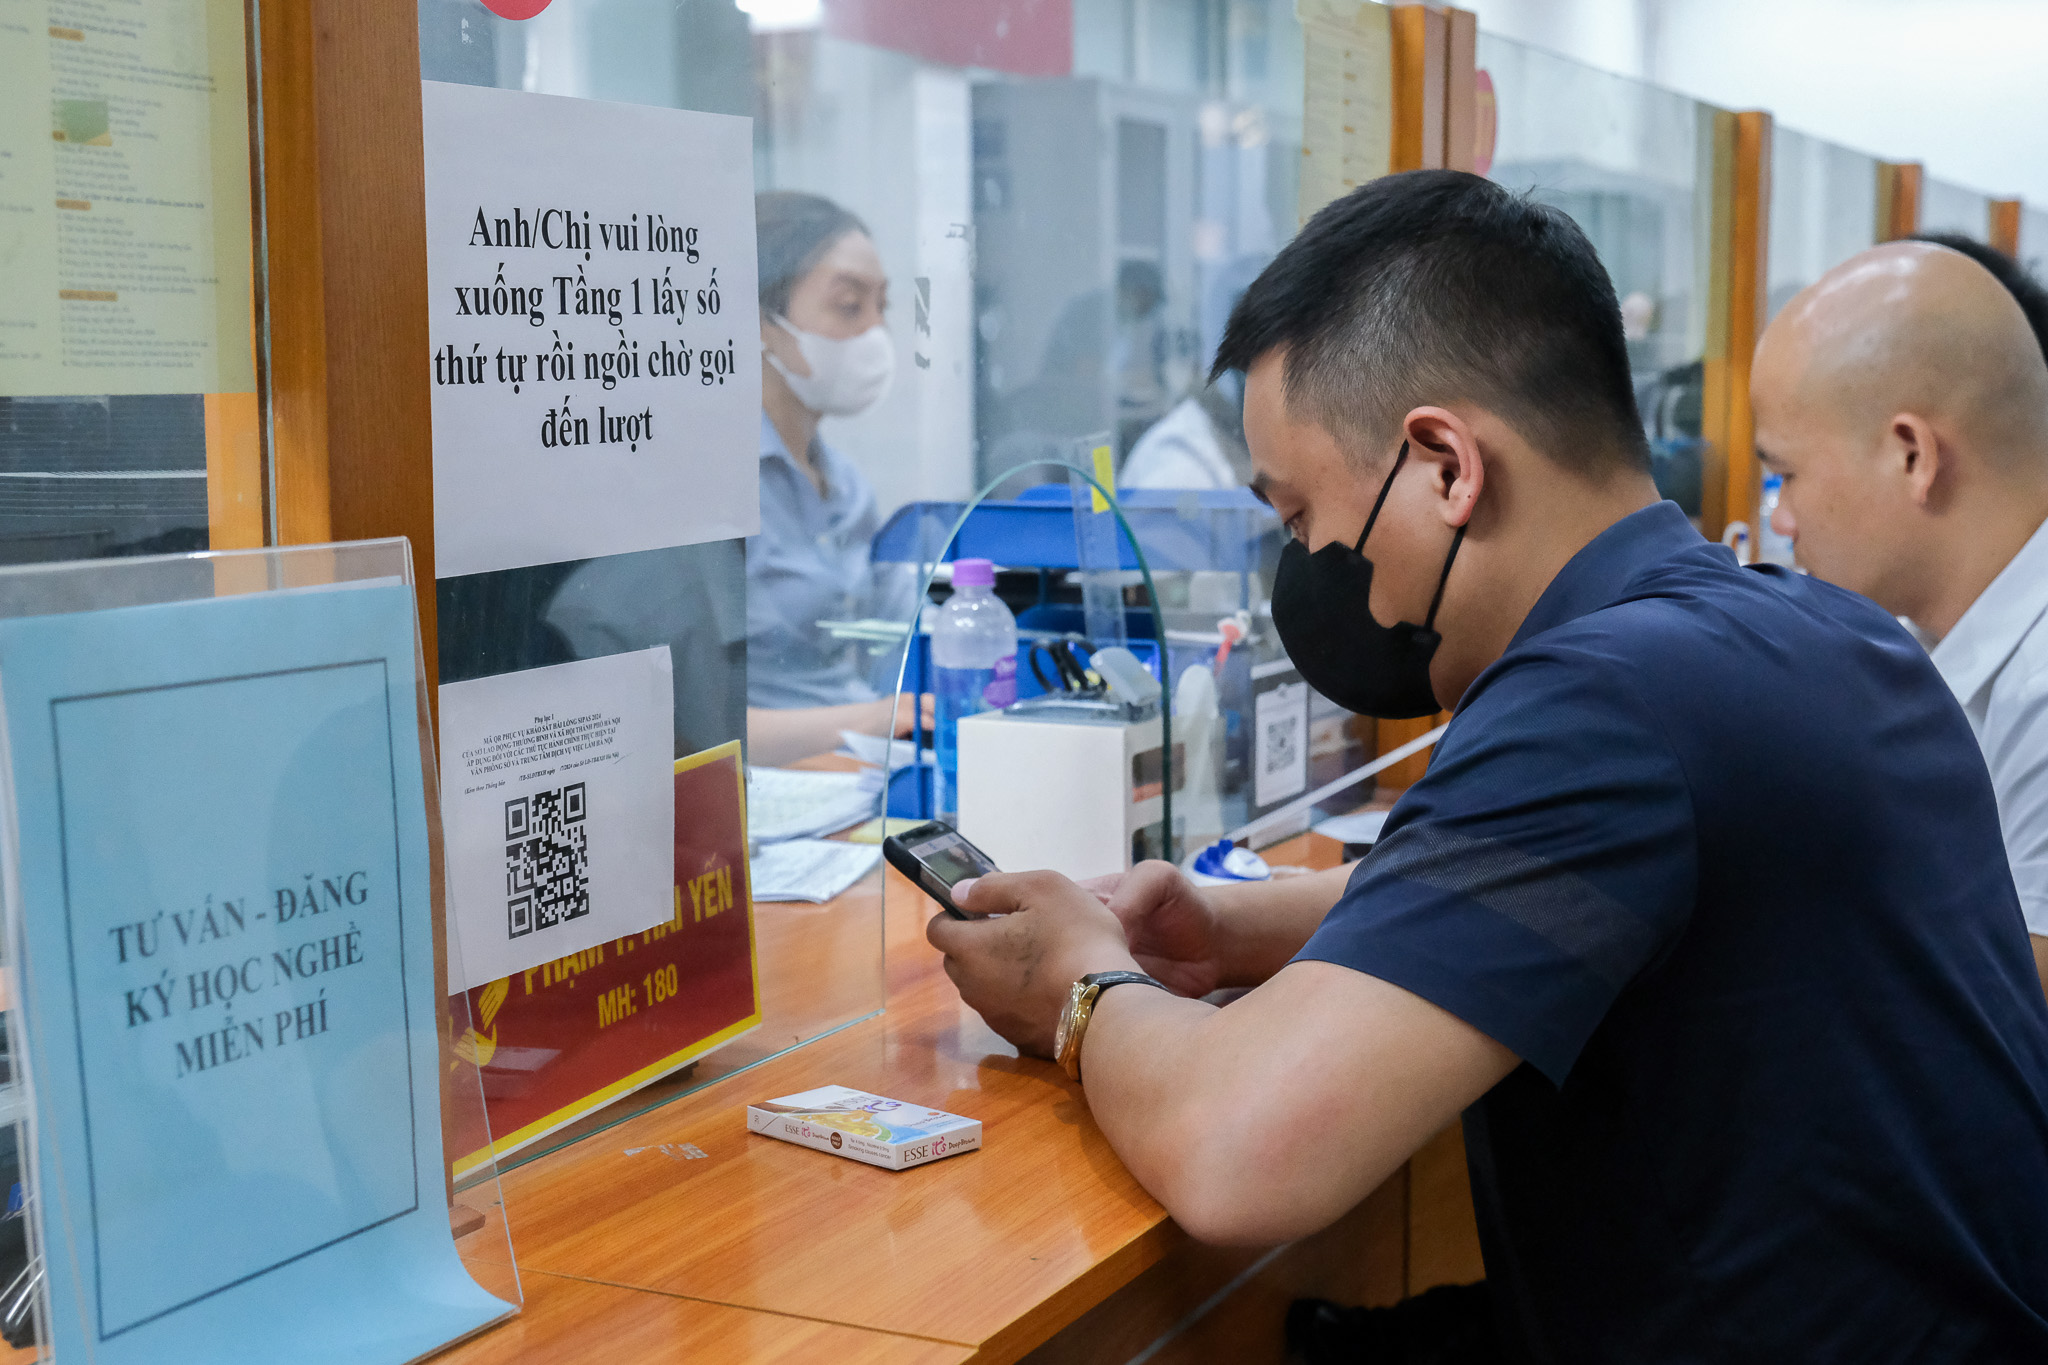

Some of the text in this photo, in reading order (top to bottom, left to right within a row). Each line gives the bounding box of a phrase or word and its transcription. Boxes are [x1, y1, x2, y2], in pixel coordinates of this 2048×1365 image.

[469, 205, 700, 264] Anh/Chị vui lòng
[455, 262, 721, 327] xuống Tầng 1 lấy số
[434, 329, 736, 395] thứ tự rồi ngồi chờ gọi
[541, 395, 654, 453] đến lượt
[484, 746, 495, 754] LAO
[513, 736, 535, 747] THƯƠNG
[576, 724, 593, 733] THÀNH
[502, 732, 516, 740] PHỤC
[526, 726, 542, 735] KHẢO
[542, 723, 552, 732] SÁT
[563, 719, 577, 727] LÒNG
[578, 715, 591, 723] SIPAS
[520, 755, 539, 765] TRUNG
[108, 910, 164, 964] TƯ
[275, 871, 368, 924] ĐĂNG
[687, 852, 734, 923] YẾN
[125, 921, 364, 1028] KÝ HỌC NGHỀ
[598, 963, 679, 1029] MH: 180
[175, 987, 330, 1079] MIỄN PHÍ
[785, 1124, 800, 1136] ESSE
[904, 1145, 928, 1162] ESSE
[932, 1136, 947, 1156] it's
